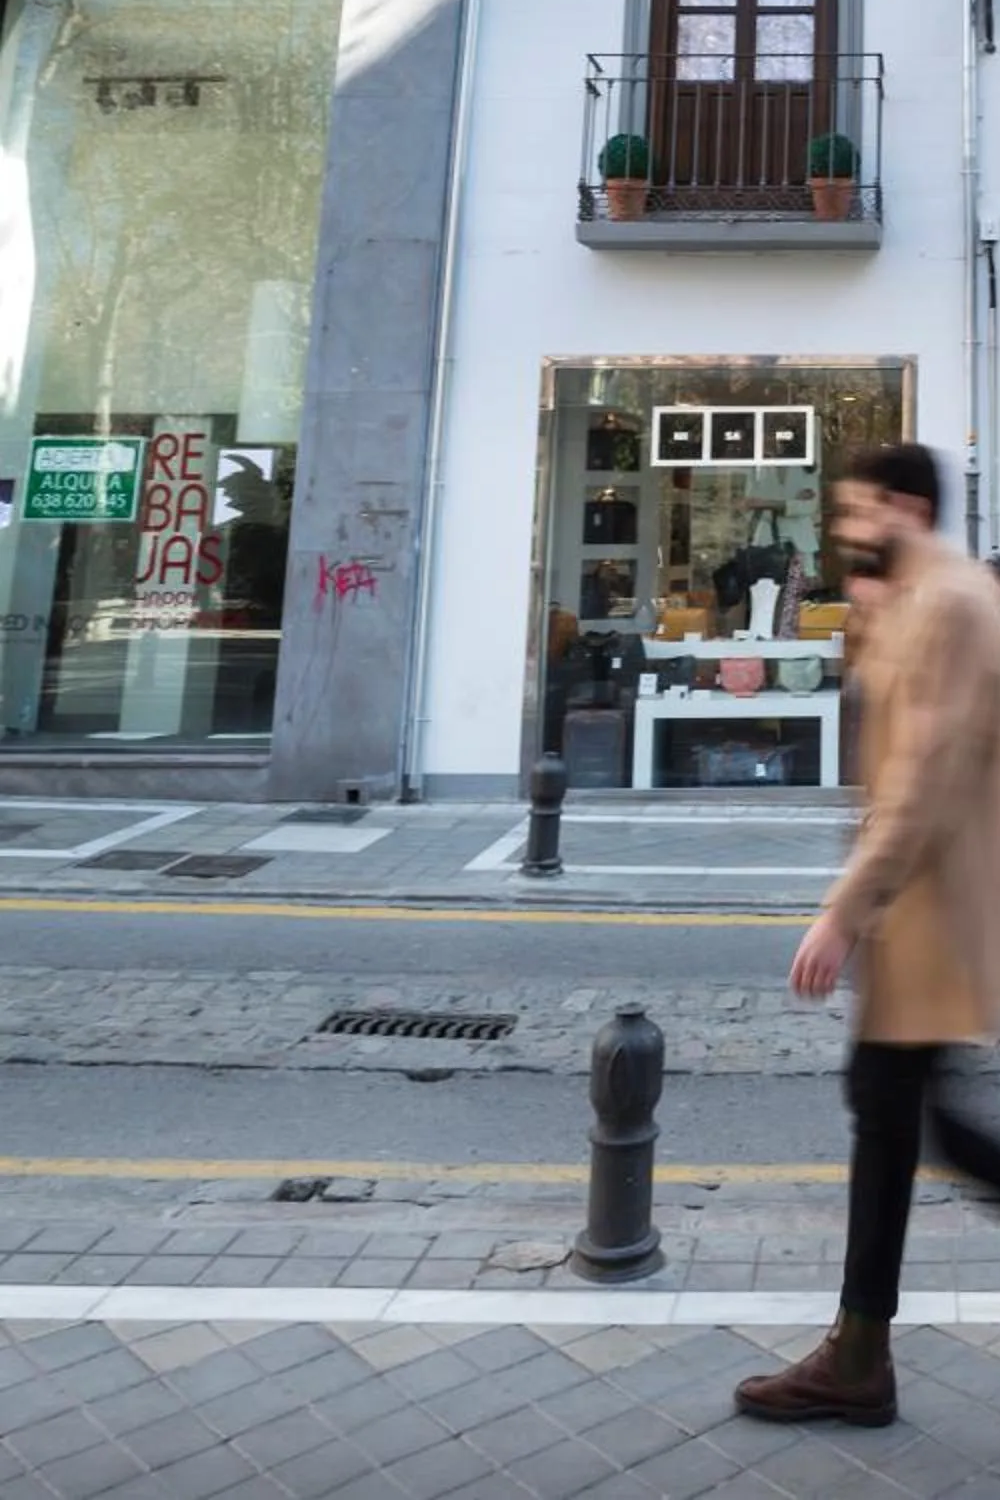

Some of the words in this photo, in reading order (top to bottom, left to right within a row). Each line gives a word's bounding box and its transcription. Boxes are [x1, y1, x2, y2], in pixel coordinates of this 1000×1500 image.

[146, 432, 206, 480] RE
[40, 472, 123, 492] ALQUA
[31, 493, 62, 509] 638
[142, 483, 208, 532] BA
